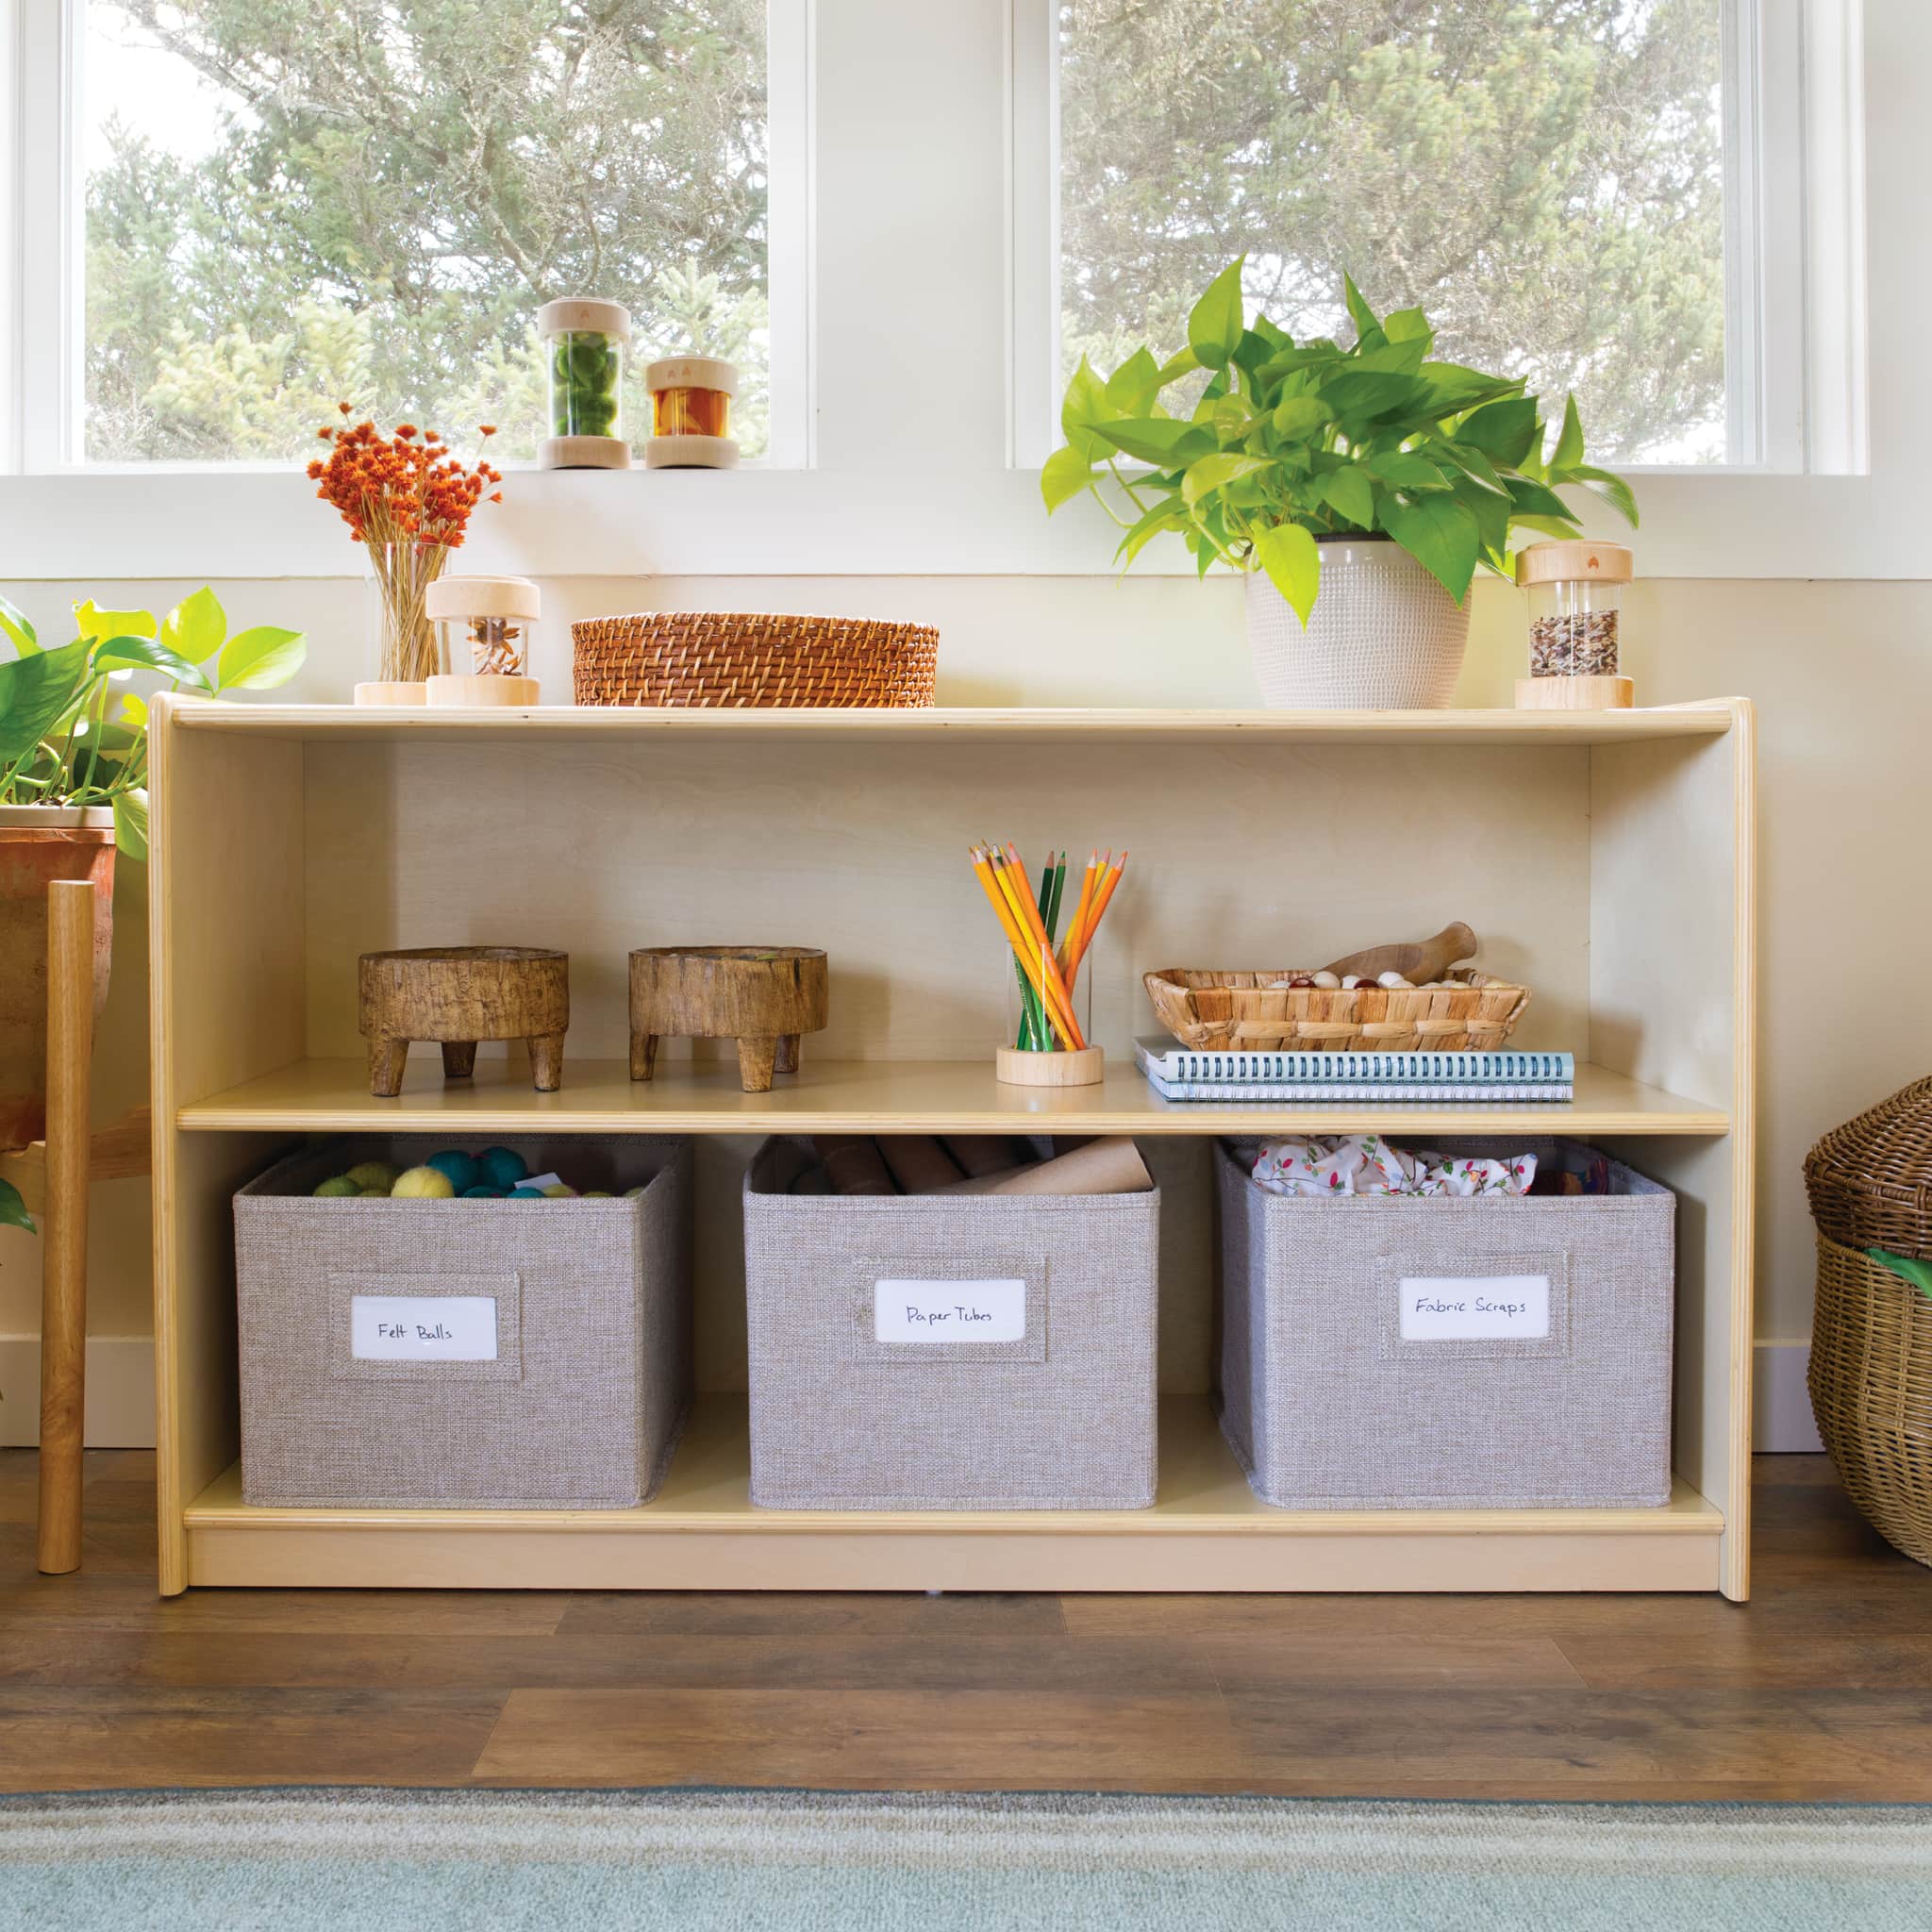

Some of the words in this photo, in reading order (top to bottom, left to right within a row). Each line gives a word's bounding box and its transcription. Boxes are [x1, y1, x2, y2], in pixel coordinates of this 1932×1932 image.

[907, 1306, 951, 1325] Paper
[955, 1307, 991, 1322] Tubes
[1415, 1298, 1466, 1313] Fabric
[1475, 1297, 1525, 1318] Scraps
[378, 1324, 407, 1338] Felt
[416, 1324, 453, 1340] Balls
